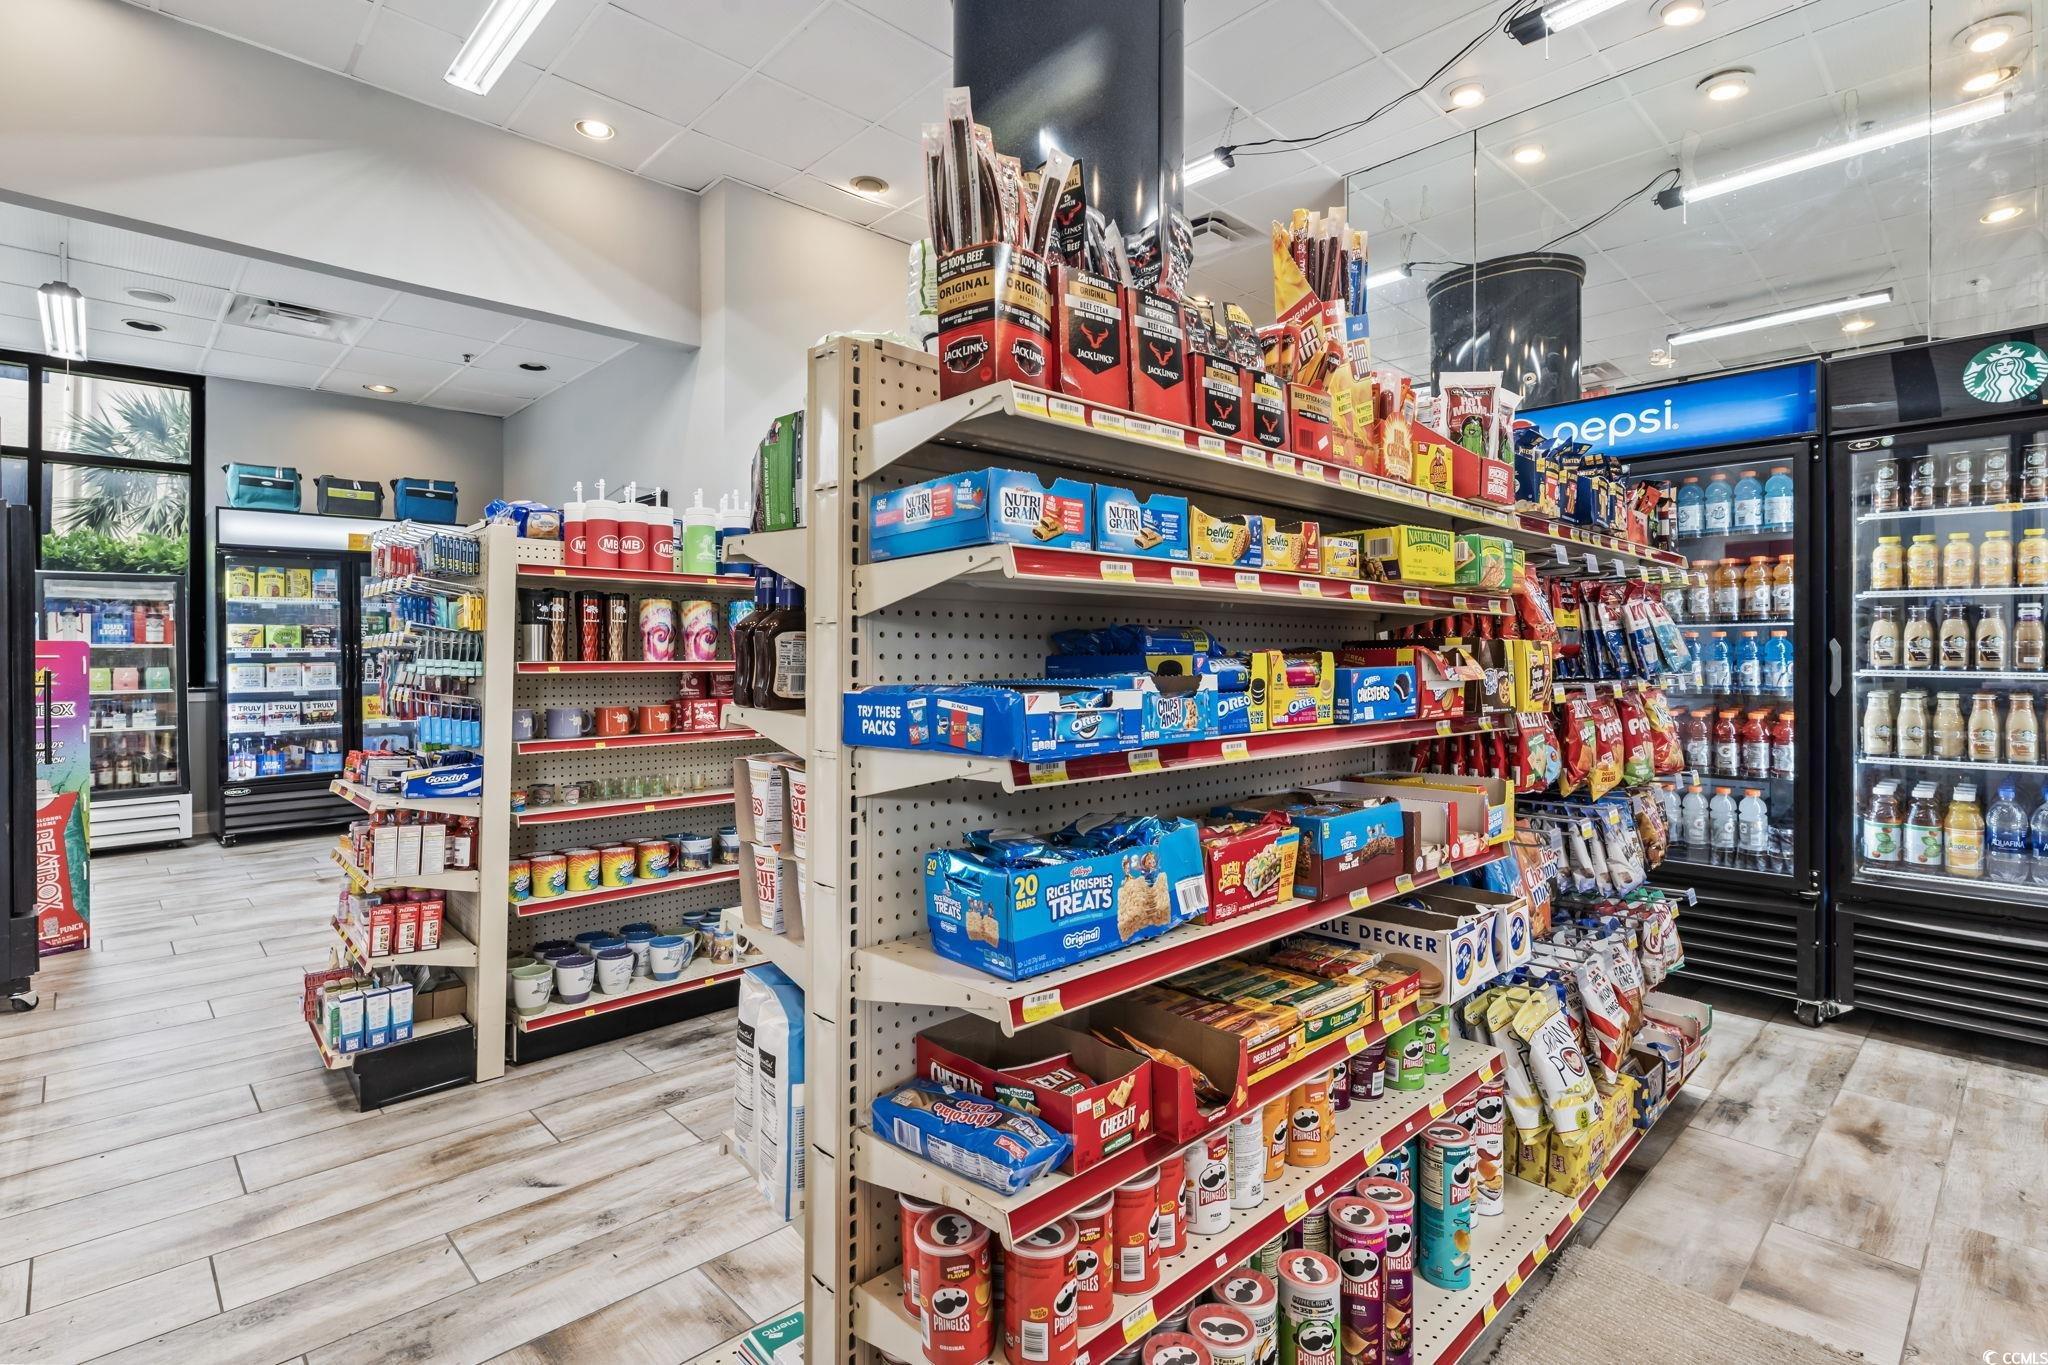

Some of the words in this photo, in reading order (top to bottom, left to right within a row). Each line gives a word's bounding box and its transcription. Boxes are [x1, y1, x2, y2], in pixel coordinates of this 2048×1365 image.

[966, 249, 985, 264] BEEF
[939, 276, 990, 299] ORIGINAL
[1080, 286, 1108, 301] ORIGINAL
[1080, 301, 1092, 311] BEEF
[1093, 304, 1109, 315] STEAK
[1147, 321, 1159, 332] BEEF
[1160, 324, 1173, 334] STEAK
[943, 348, 962, 362] JACK
[1011, 344, 1029, 358] JACK
[1077, 348, 1094, 360] JACK
[1147, 365, 1162, 376] JACK
[1294, 392, 1305, 400] BEEF
[1306, 394, 1317, 402] STICK
[1552, 399, 1673, 447] pepsi
[905, 492, 930, 509] NUTRI
[1004, 492, 1041, 507] NUTRI
[905, 503, 930, 519] GRAIN
[1004, 506, 1041, 521] GRAIN
[1109, 506, 1139, 520] NUTRI
[1109, 518, 1139, 531] GRAIN
[1206, 524, 1234, 539] belVita
[622, 540, 641, 550] MB
[1266, 534, 1289, 547] belVita
[1408, 529, 1430, 545] NATURE
[1429, 531, 1450, 548] VALLEY
[659, 543, 673, 553] MB
[1416, 545, 1431, 553] FRUIT
[1434, 547, 1444, 555] NUT
[99, 629, 128, 637] LIGHT
[1238, 673, 1245, 681] 10
[1276, 673, 1282, 682] 8
[1363, 674, 1381, 687] OREO
[1357, 685, 1390, 703] CAKESTERS
[857, 704, 873, 717] TRY
[874, 705, 901, 719] THESE
[1157, 698, 1178, 714] Chips
[1217, 696, 1251, 717] OREO
[1288, 697, 1316, 715] OREO
[862, 720, 896, 736] PACKS
[1071, 714, 1102, 732] OREO
[1250, 717, 1264, 725] SIZE
[426, 772, 469, 784] Goody's
[1991, 839, 2025, 849] AQUAFINA
[926, 858, 937, 870] 20
[1339, 861, 1351, 872] MEGA
[1014, 874, 1039, 900] 20
[1046, 883, 1070, 900] RICE
[1070, 875, 1113, 893] KRISPIES
[933, 894, 942, 903] RICE
[942, 895, 961, 909] KRISPIES
[1015, 897, 1036, 911] BARS
[1048, 889, 1112, 921] TREATS
[934, 902, 961, 920] TREATS
[1064, 928, 1099, 948] Original
[1312, 918, 1350, 936] BLE
[1359, 924, 1438, 954] DECKER
[956, 1099, 994, 1113] Chip
[933, 1103, 1003, 1128] Chocolate
[1100, 1104, 1137, 1139] CHEEZ-IT
[1292, 1129, 1320, 1142] PRINGLES
[1200, 1185, 1228, 1205] PRINGLES
[947, 1271, 970, 1280] FLAVOR
[762, 1317, 799, 1337] memo
[933, 1313, 971, 1332] PRINGLES
[1297, 1349, 1335, 1365] PRINGLES
